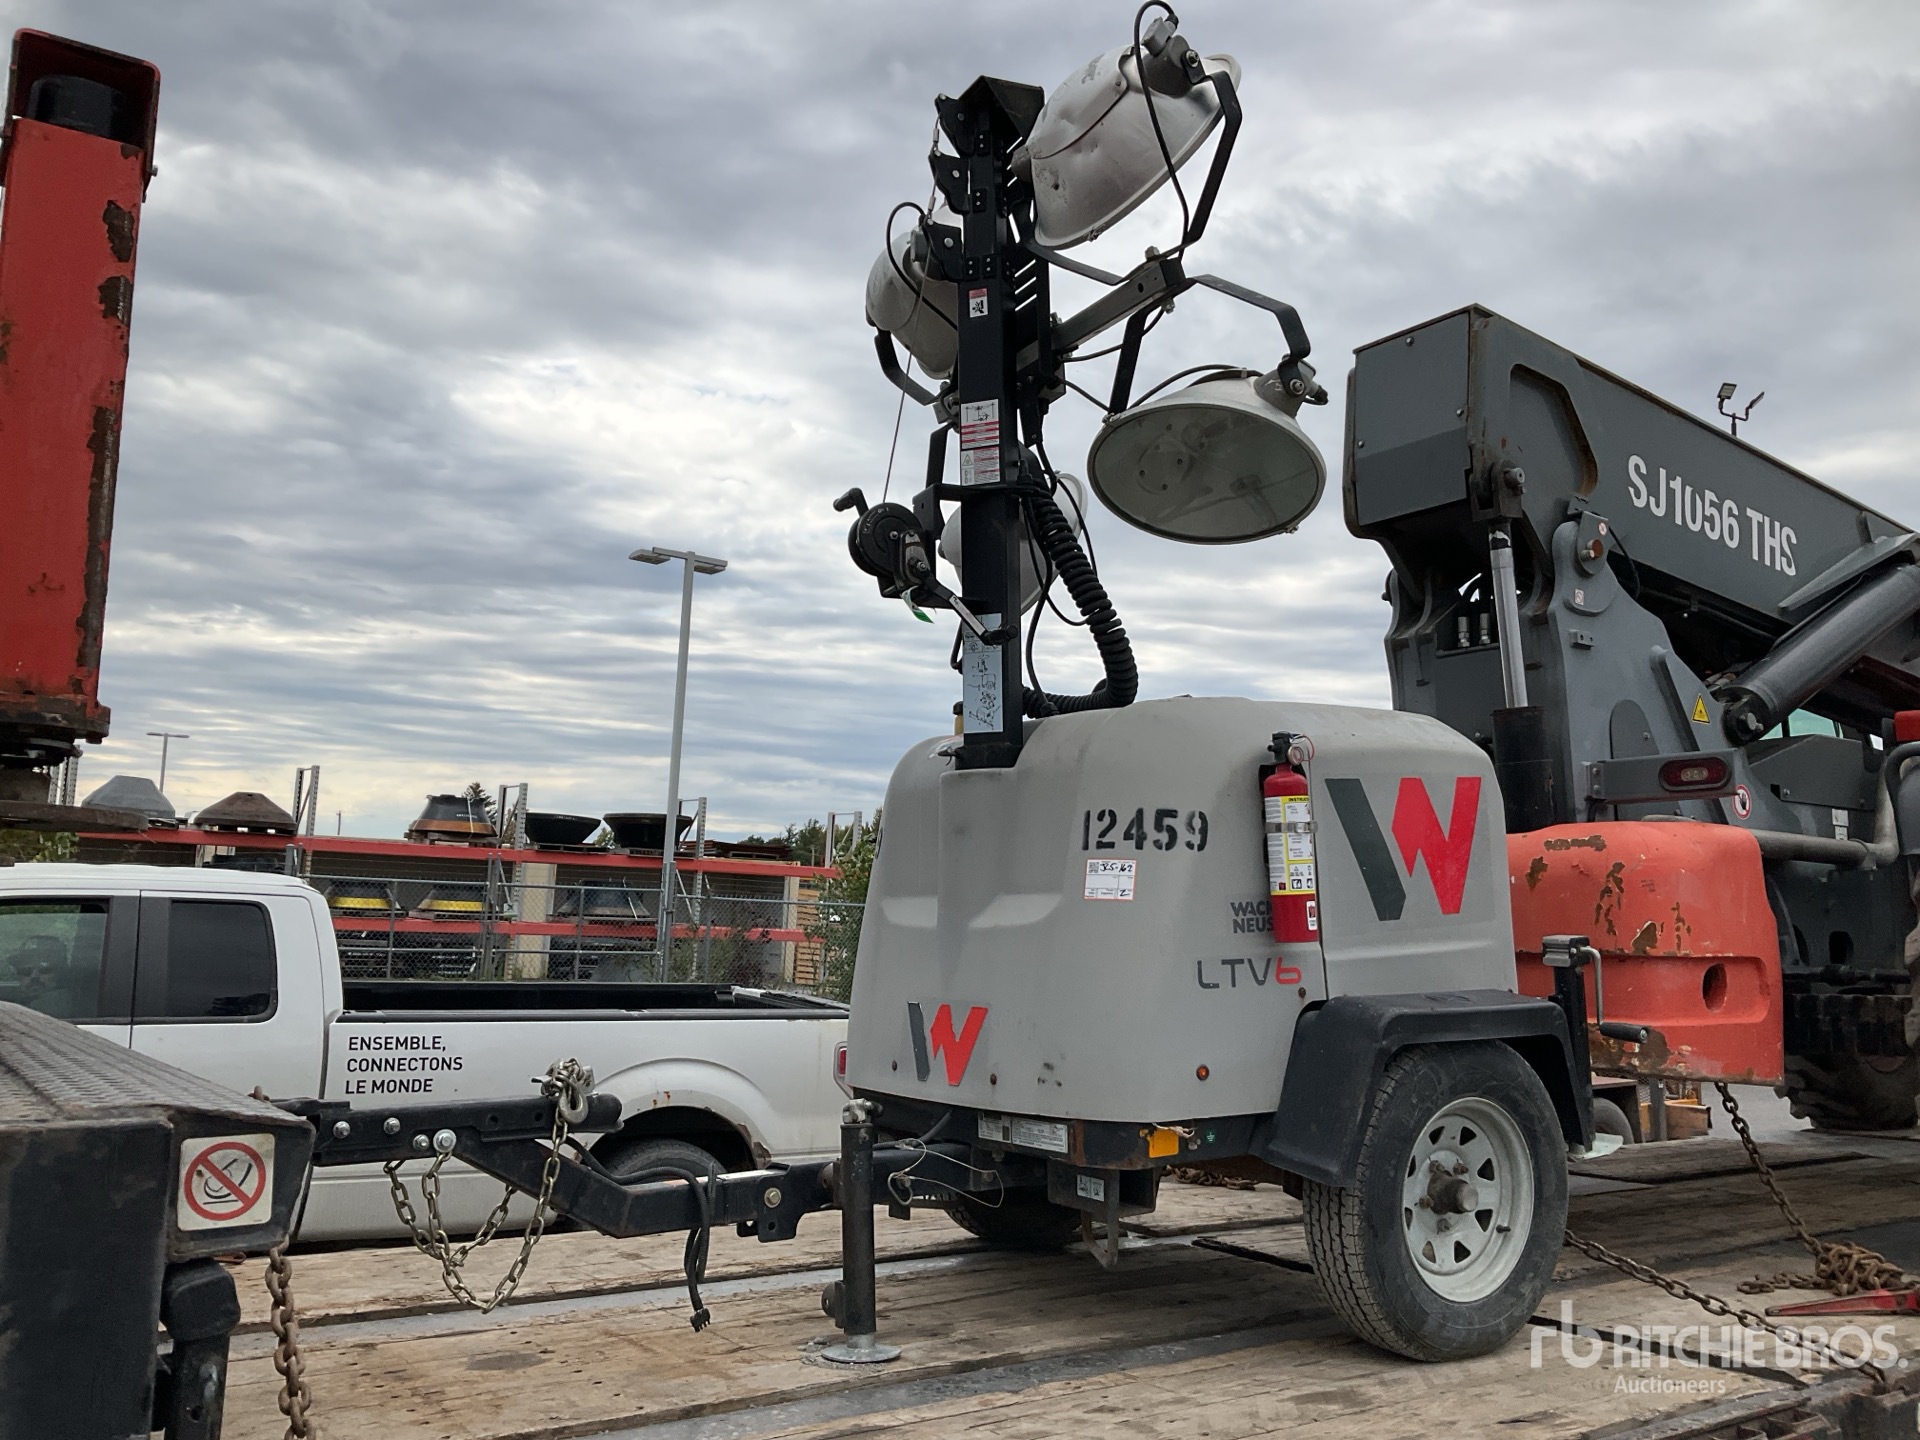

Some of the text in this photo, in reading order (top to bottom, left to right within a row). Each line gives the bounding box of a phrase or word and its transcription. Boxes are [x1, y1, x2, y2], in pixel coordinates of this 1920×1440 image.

[1628, 455, 1797, 576] SJ1056 THS
[1082, 808, 1209, 852] 12459
[1197, 956, 1302, 989] LTV6
[348, 1036, 446, 1052] ENSEMBLE,
[347, 1056, 463, 1073] CONNECTONS
[345, 1078, 433, 1094] LE MONDE
